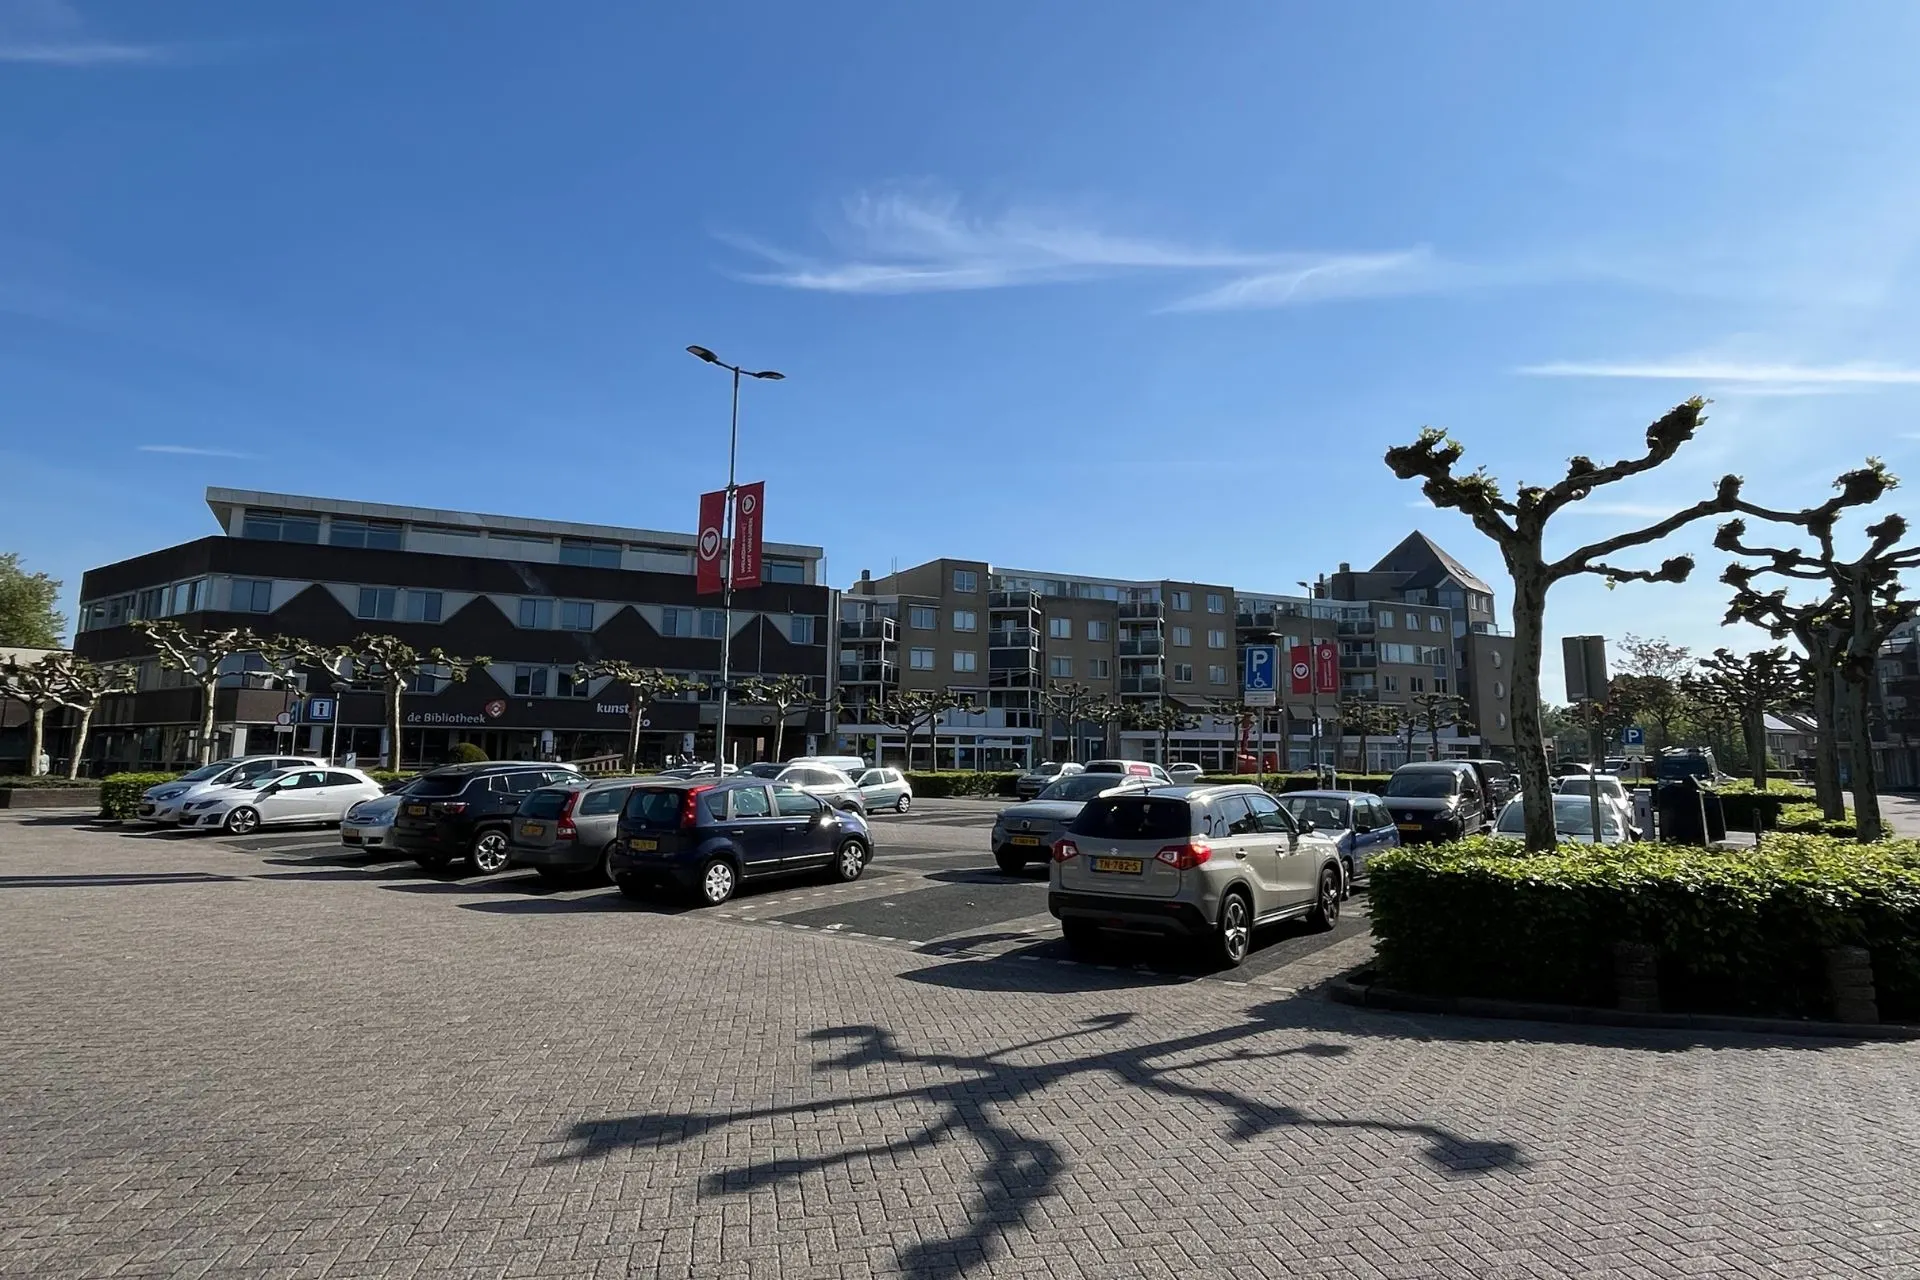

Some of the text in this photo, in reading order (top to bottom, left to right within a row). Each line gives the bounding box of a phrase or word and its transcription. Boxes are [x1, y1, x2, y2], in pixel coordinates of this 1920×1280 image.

[1252, 650, 1268, 672] P
[596, 702, 630, 714] kunst
[407, 712, 487, 724] de Bibliotheek
[1628, 729, 1640, 743] P
[1099, 859, 1138, 871] TN-782-S
